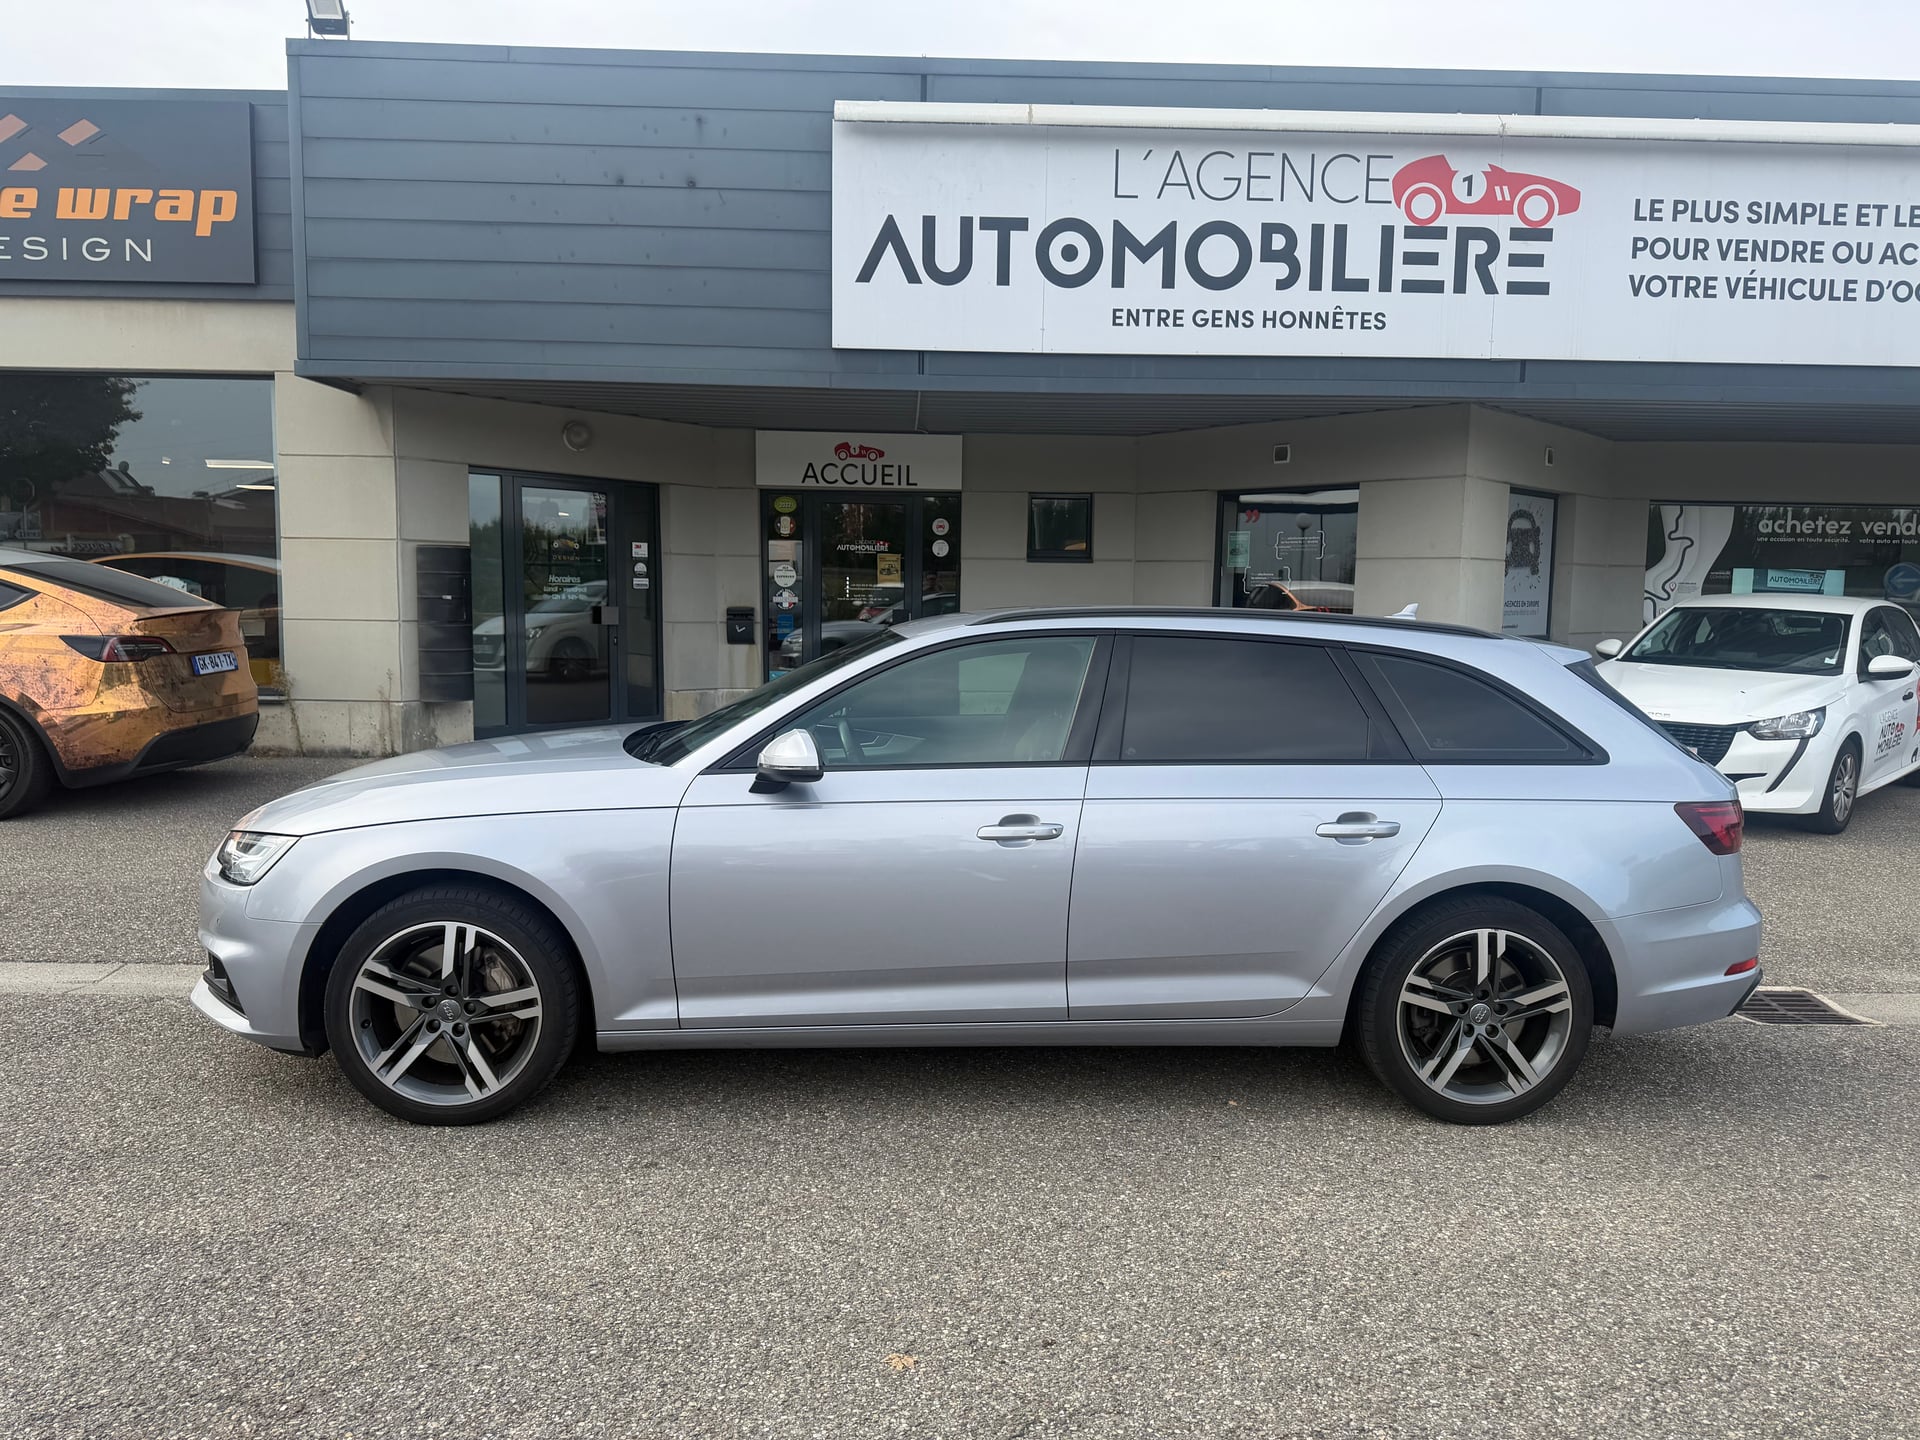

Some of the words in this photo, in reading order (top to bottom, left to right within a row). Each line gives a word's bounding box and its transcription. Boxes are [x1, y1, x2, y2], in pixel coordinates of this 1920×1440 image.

[55, 187, 238, 237] wrap
[1634, 198, 1665, 222] LE
[1671, 199, 1740, 224] PLUS
[1746, 201, 1849, 226] SIMPLE
[1855, 203, 1889, 227] ET
[1893, 204, 1920, 228] LE
[1631, 236, 1710, 261] POUR
[1716, 238, 1825, 264] VENDRE
[1832, 241, 1874, 265] OU
[1878, 242, 1919, 266] AC
[1628, 274, 1718, 299] VOTRE
[1724, 269, 1858, 302] VÉHICULE
[1865, 279, 1920, 303] D'O
[1111, 308, 1185, 328] ENTRE
[1191, 309, 1255, 329] GENS
[1262, 305, 1387, 331] HONNÊTES
[800, 461, 919, 487] ACCUEIL
[1758, 511, 1852, 535] achetez
[1861, 513, 1920, 536] vend
[548, 574, 581, 583] Horaires
